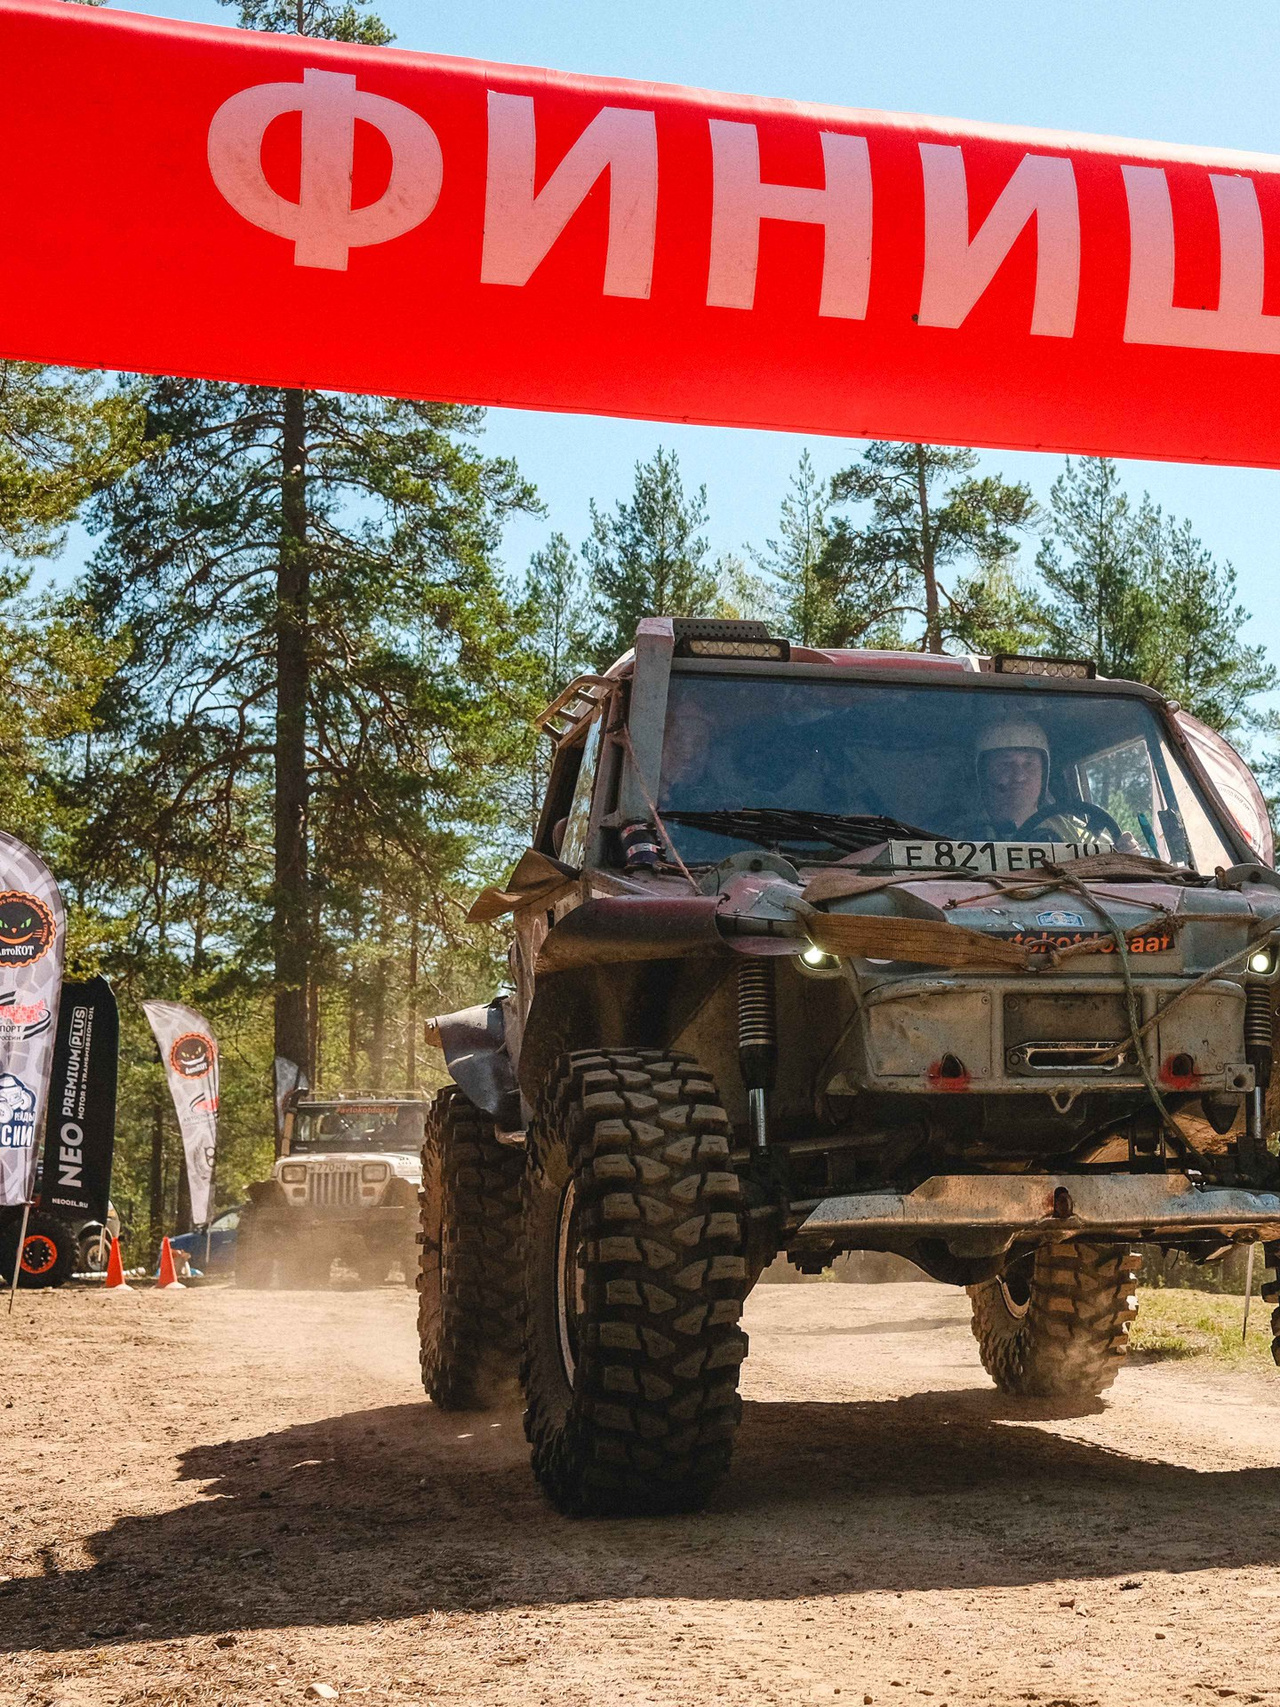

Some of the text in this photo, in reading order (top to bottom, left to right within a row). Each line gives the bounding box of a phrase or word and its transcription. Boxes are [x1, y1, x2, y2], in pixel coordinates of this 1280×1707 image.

[934, 842, 997, 871] 821
[62, 1009, 85, 1117] PREMIUM PLUS
[78, 1090, 87, 1120] MOTOR
[58, 1122, 83, 1188] NEO
